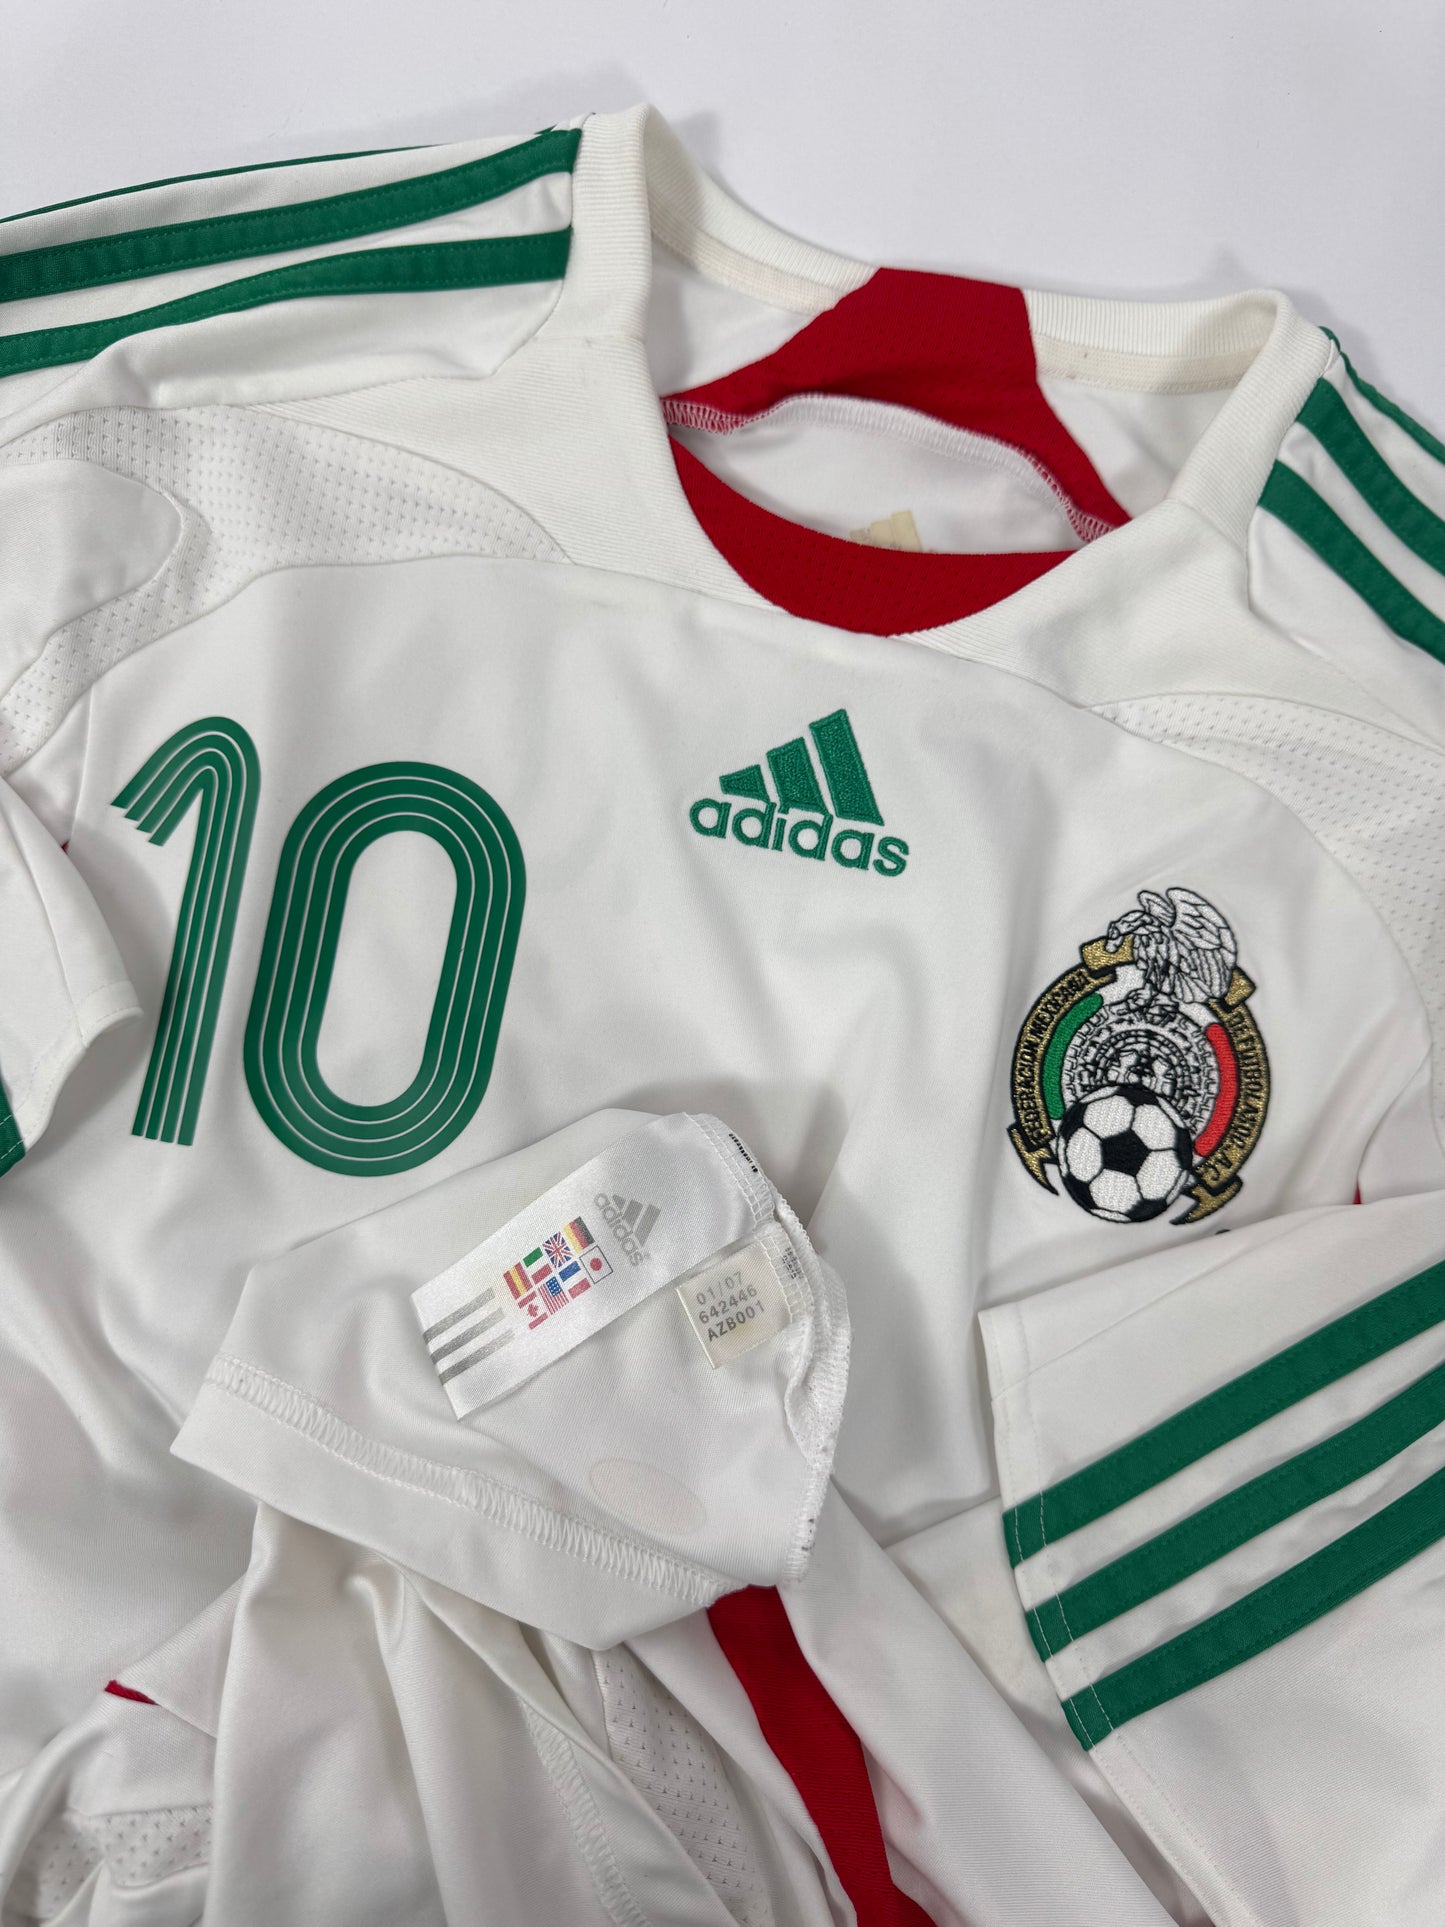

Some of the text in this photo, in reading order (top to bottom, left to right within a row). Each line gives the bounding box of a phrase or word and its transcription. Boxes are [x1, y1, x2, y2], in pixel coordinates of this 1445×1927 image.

[689, 798, 909, 876] adidas
[110, 716, 526, 1177] 10
[1018, 1040, 1053, 1147] FEDERACION
[594, 1193, 643, 1267] adidas
[696, 1271, 742, 1305] 01/07
[699, 1284, 757, 1324] 642446
[707, 1300, 765, 1341] AZB001
